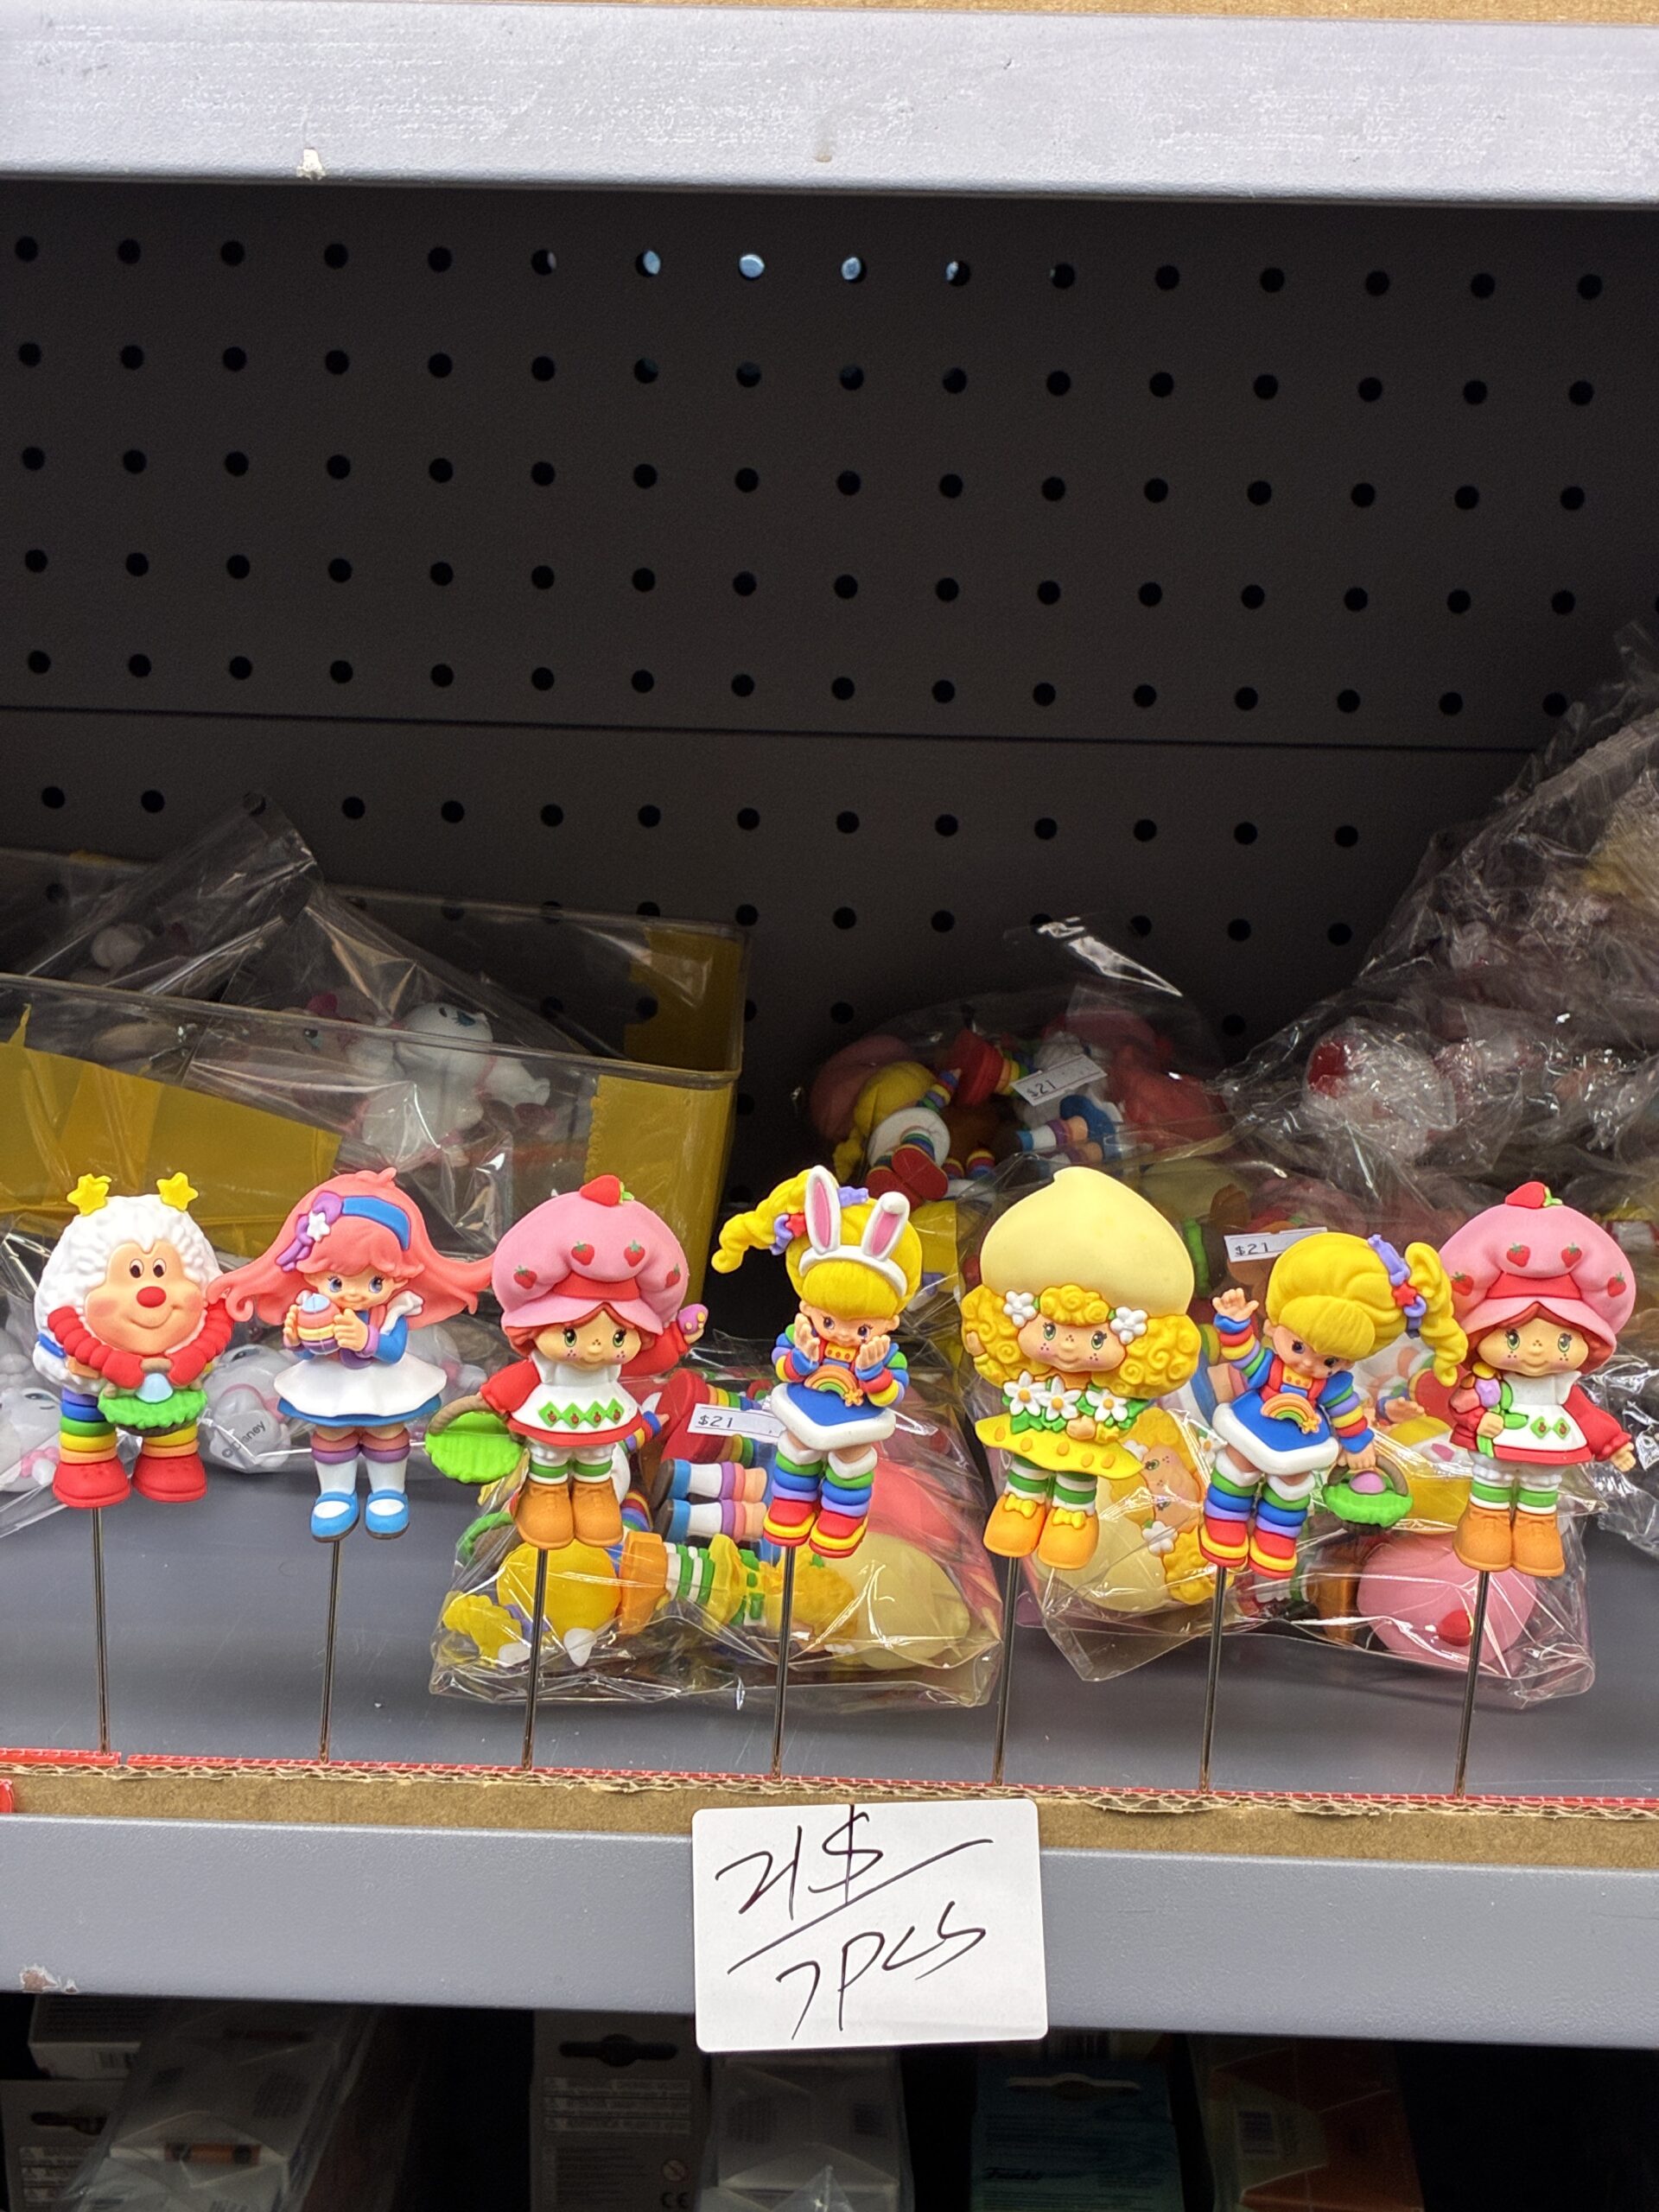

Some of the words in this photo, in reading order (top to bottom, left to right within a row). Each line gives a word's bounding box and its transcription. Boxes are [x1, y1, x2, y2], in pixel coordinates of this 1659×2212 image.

[1027, 1079, 1057, 1098] $21
[1235, 1243, 1268, 1256] $21
[698, 1414, 734, 1428] $21
